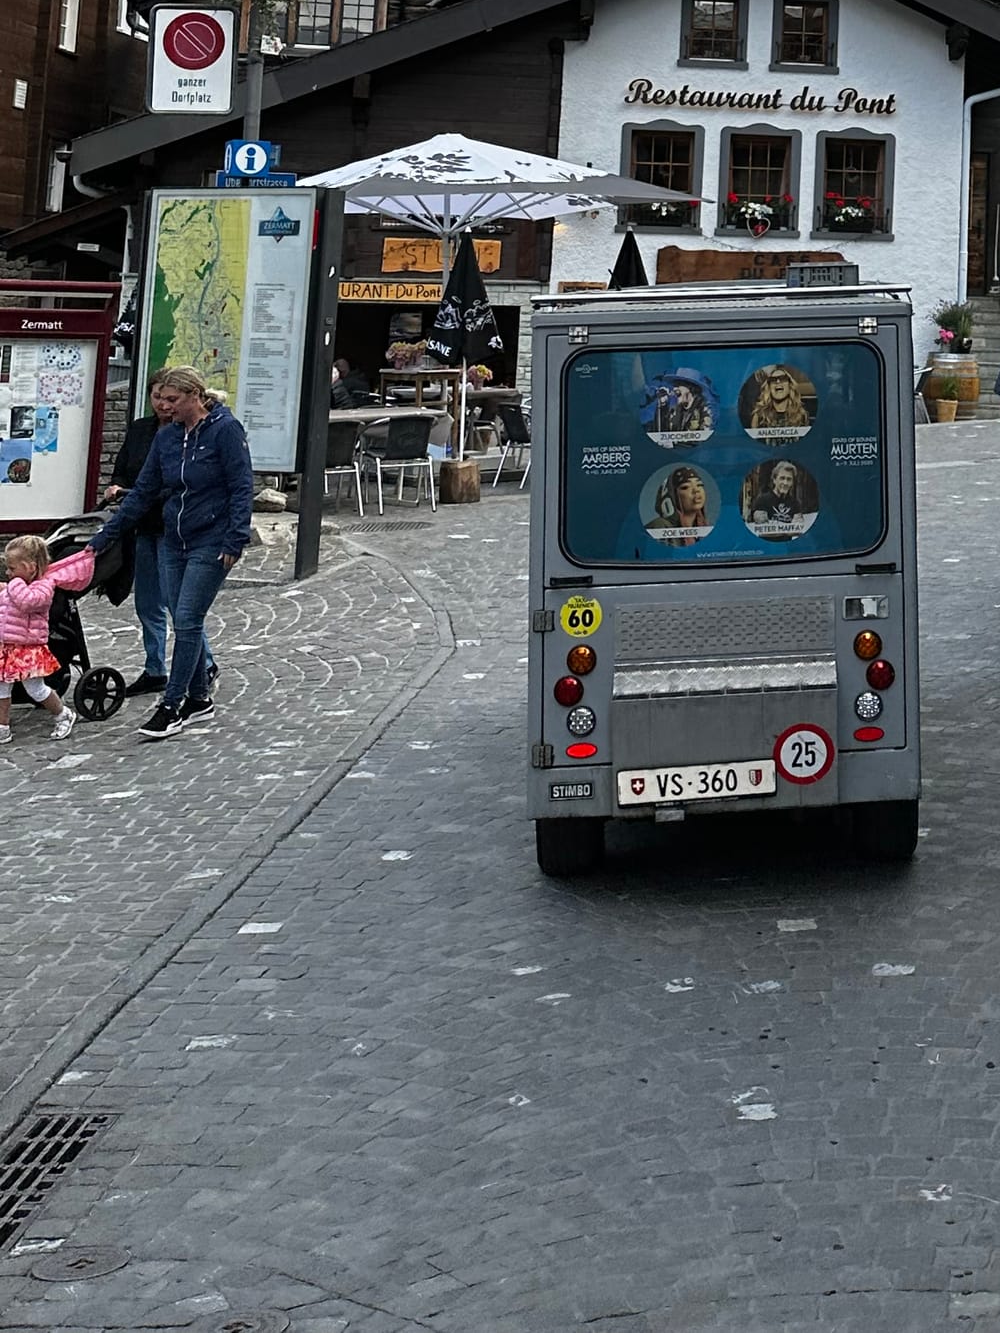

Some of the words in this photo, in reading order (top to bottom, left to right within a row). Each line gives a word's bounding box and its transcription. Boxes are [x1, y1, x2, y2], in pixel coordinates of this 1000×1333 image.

[177, 78, 207, 88] ganzer
[171, 91, 212, 105] Dorfplatz
[624, 78, 783, 110] Restaurant
[790, 86, 825, 112] du
[833, 87, 896, 115] Pont
[415, 285, 441, 299] Pont
[21, 319, 63, 330] Zermatt
[830, 443, 878, 455] MURTEN
[581, 452, 631, 464] AARBERG
[568, 609, 594, 628] 60
[791, 741, 817, 768] 25
